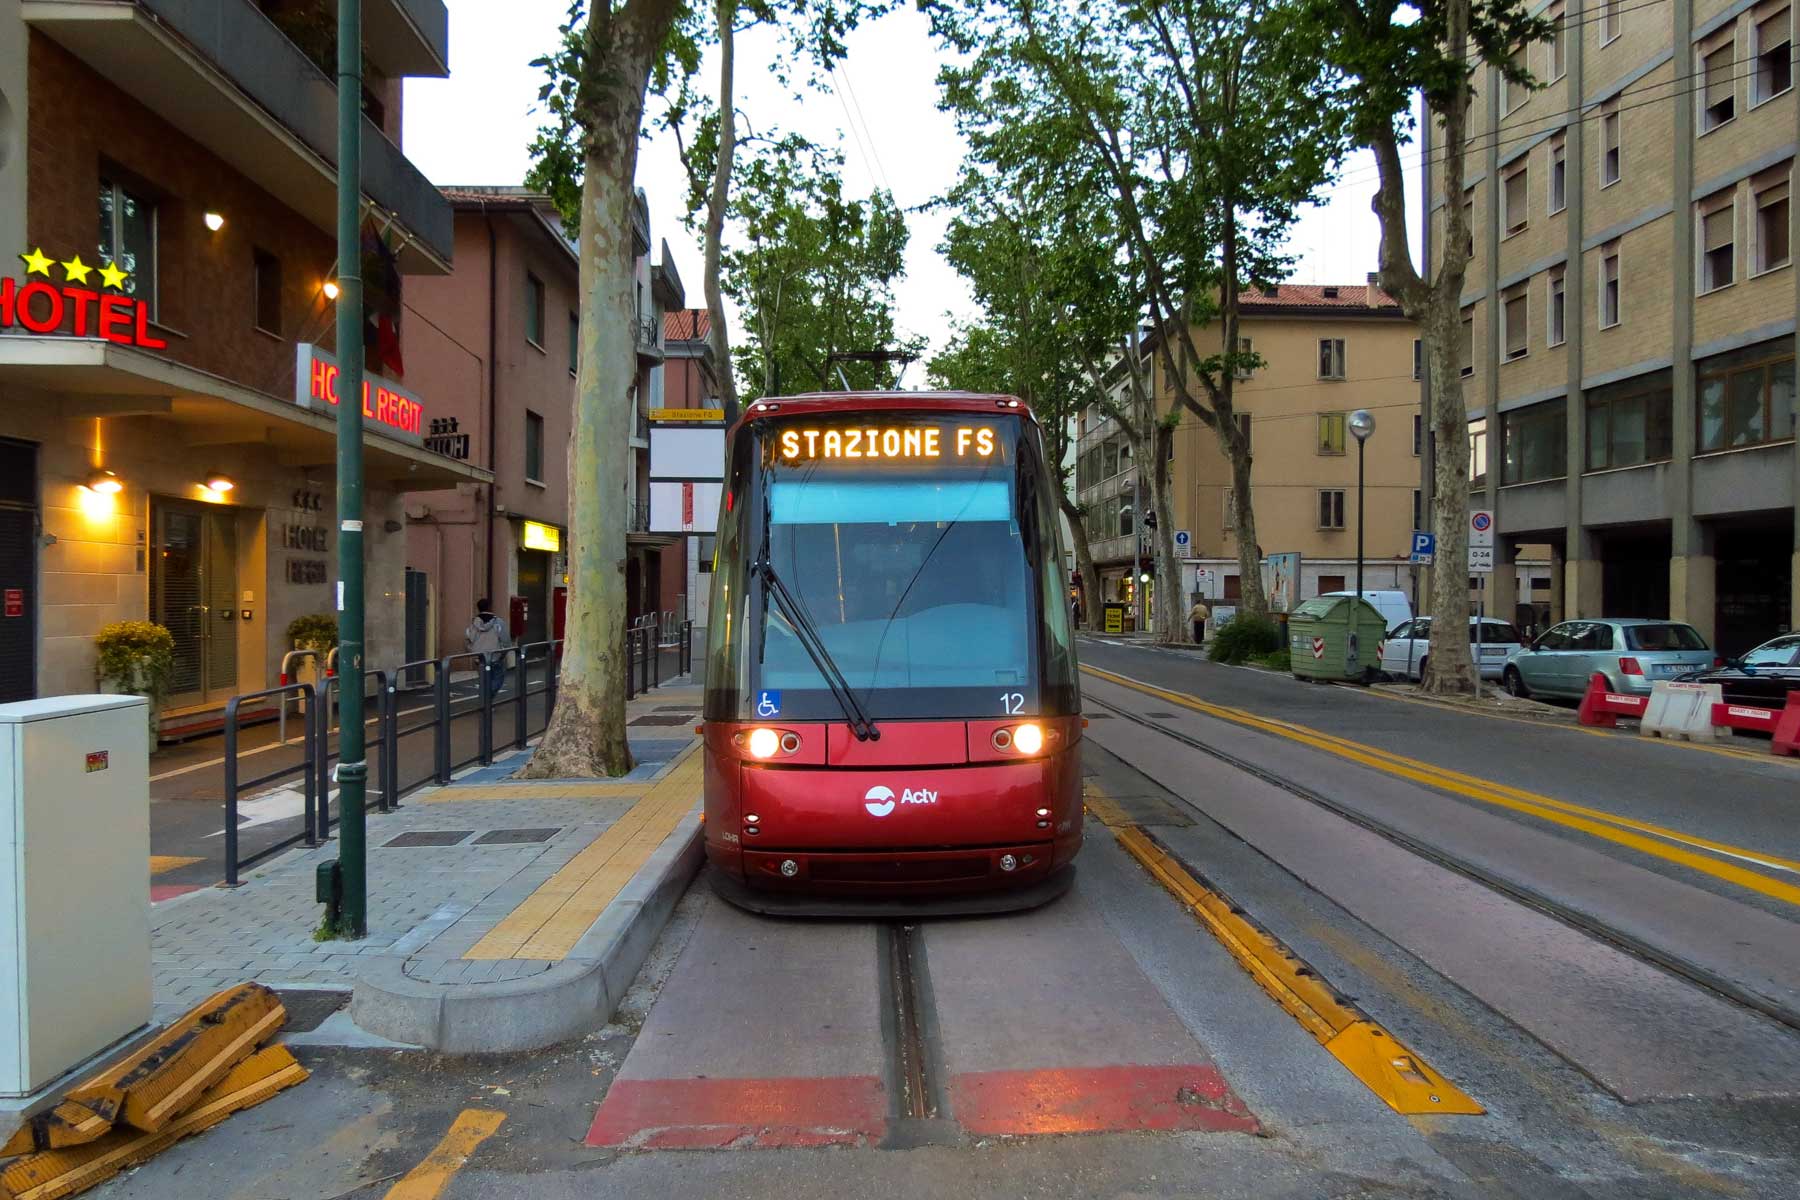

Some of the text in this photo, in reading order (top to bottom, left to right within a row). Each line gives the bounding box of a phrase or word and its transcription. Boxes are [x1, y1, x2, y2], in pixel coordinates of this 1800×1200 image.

[377, 387, 424, 435] REGIT
[781, 428, 994, 458] STAZIONE FS
[1000, 692, 1025, 715] 12
[900, 788, 938, 805] Actv
